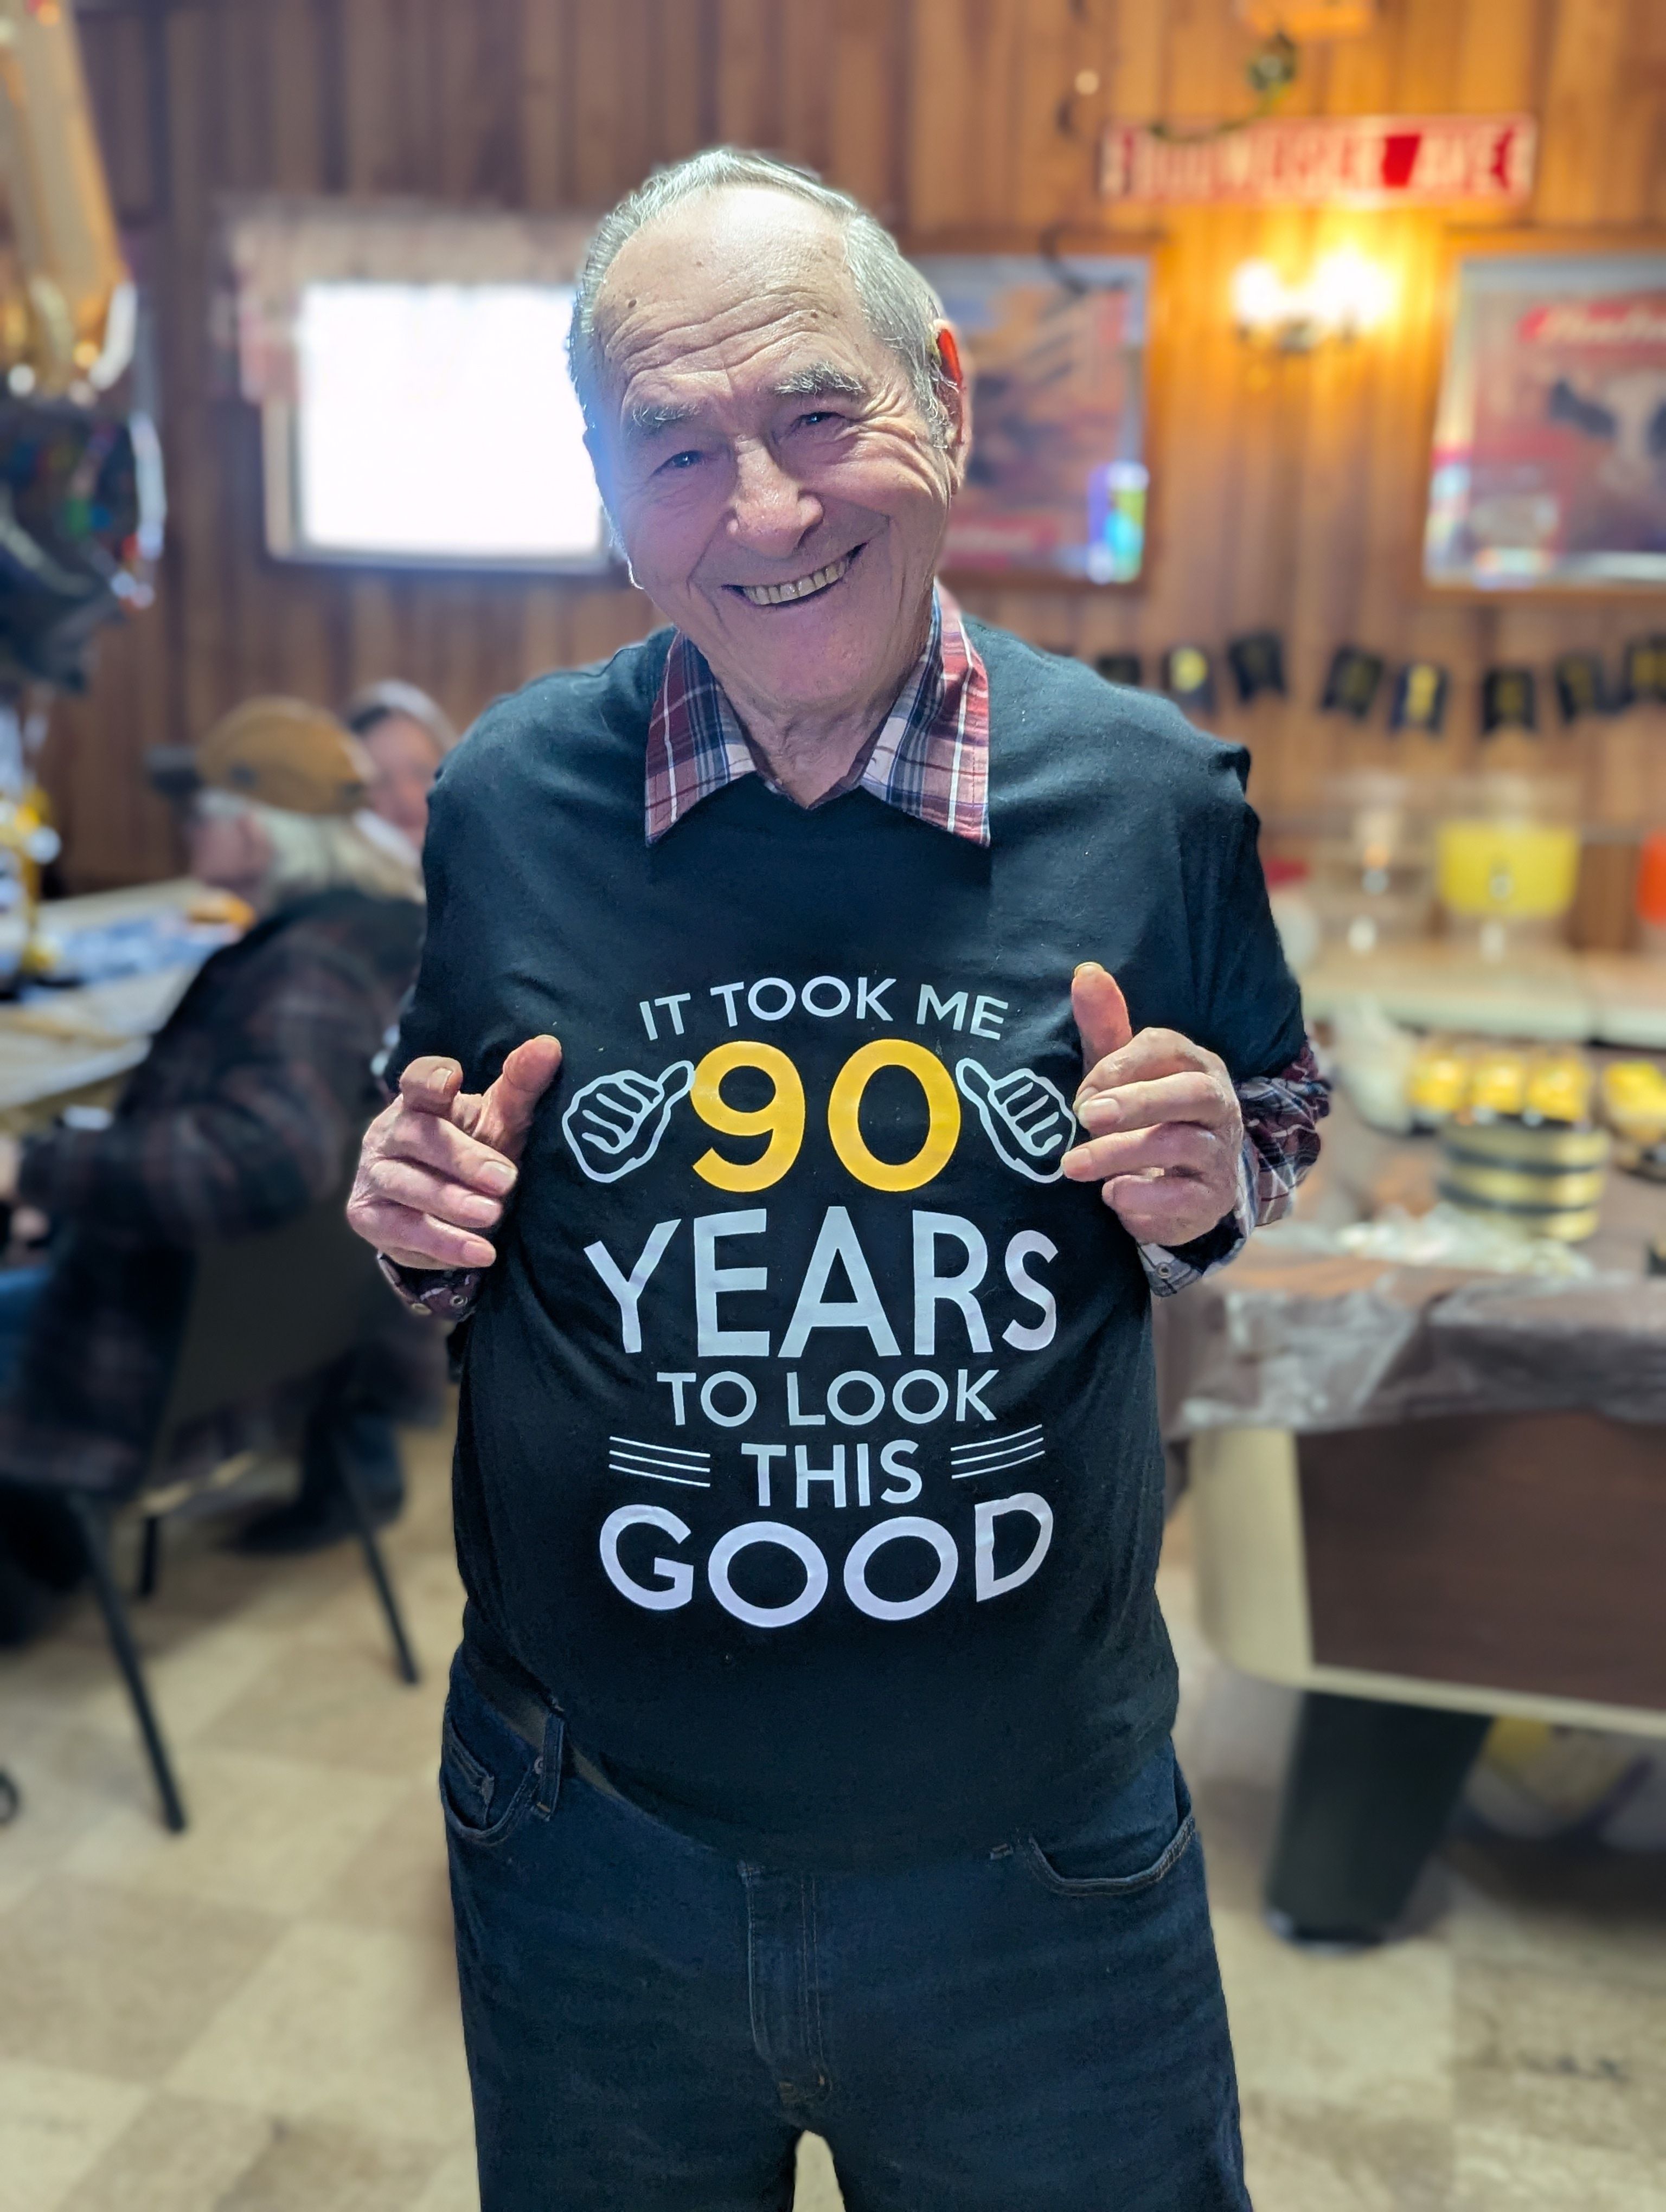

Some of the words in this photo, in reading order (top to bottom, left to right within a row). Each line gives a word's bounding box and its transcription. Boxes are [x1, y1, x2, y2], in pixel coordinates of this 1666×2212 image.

[639, 993, 691, 1041] IT
[710, 975, 897, 1027] TOOK
[917, 984, 1009, 1041] ME
[690, 1039, 961, 1192] 90
[584, 1206, 1059, 1358] YEARS
[657, 1371, 757, 1427] TO
[787, 1369, 999, 1426] LOOK
[741, 1439, 922, 1508] THIS
[600, 1493, 1054, 1628] GOOD
